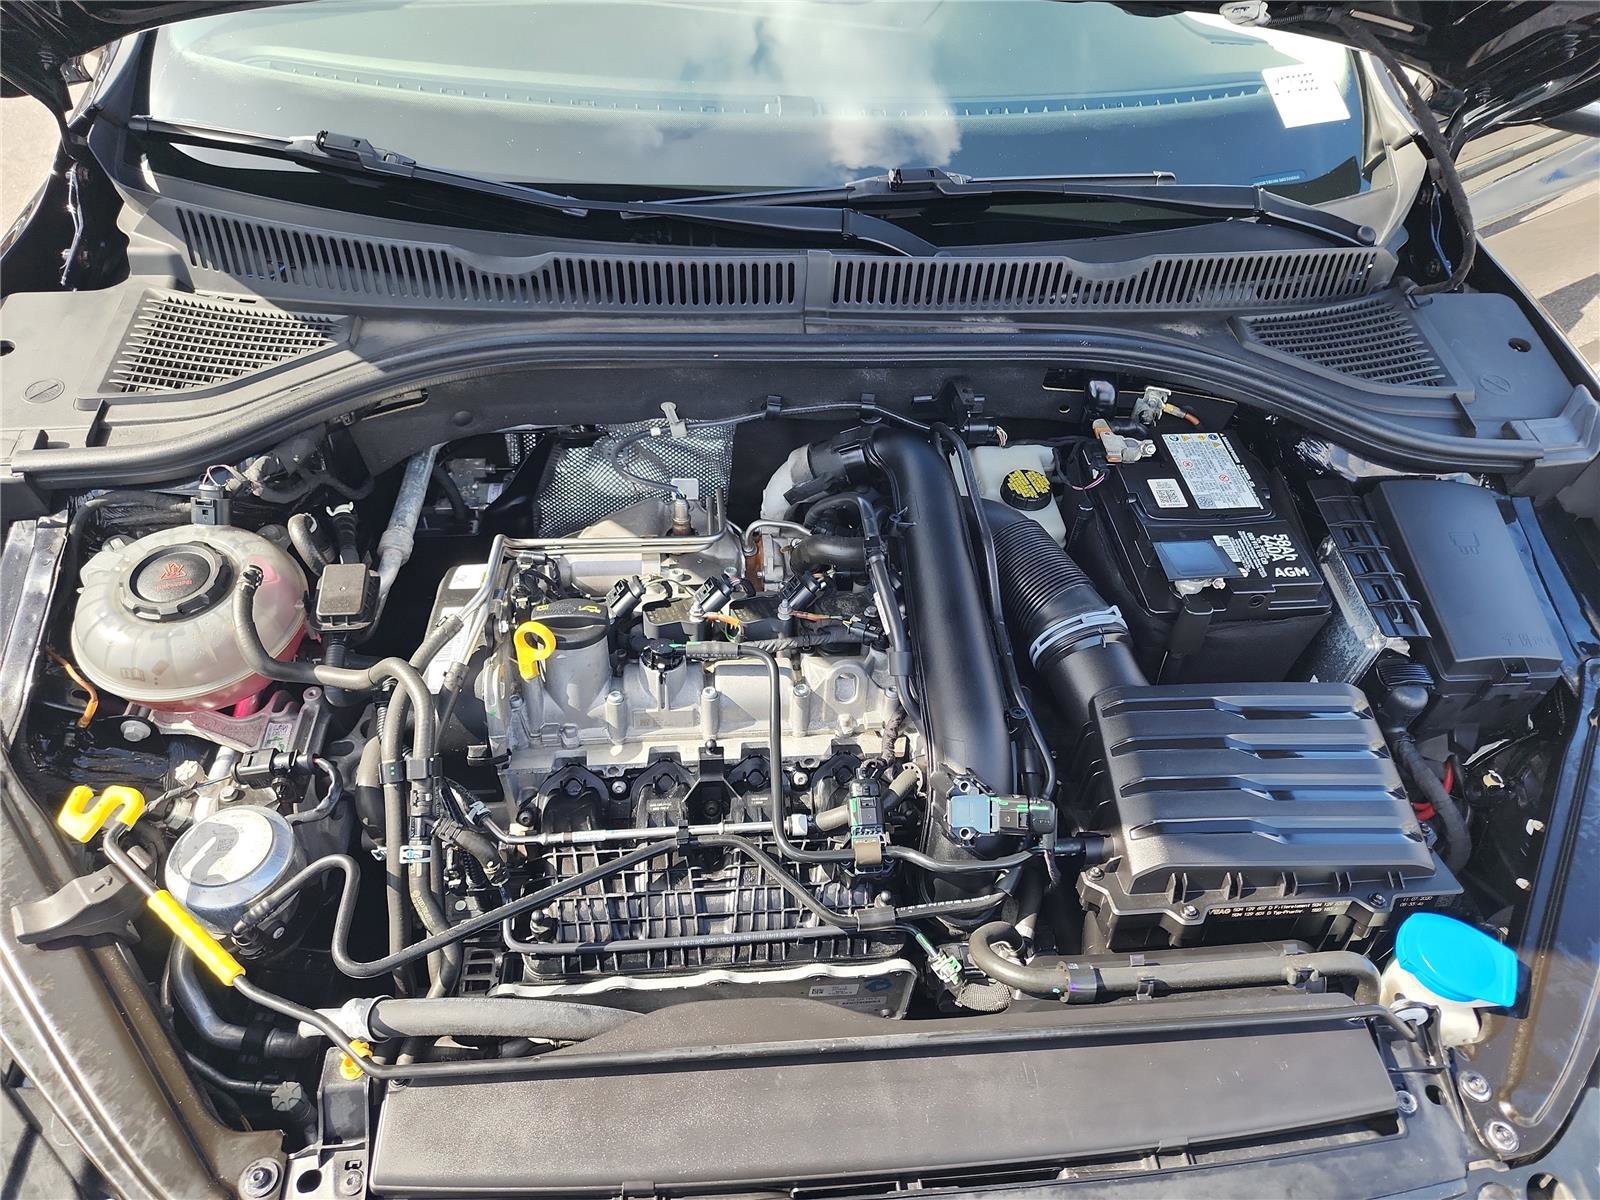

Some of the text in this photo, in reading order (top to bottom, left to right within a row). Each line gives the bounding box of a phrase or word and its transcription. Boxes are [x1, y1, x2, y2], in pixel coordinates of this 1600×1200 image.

[1260, 535, 1285, 562] 640A
[1273, 534, 1298, 561] 58Ah
[1275, 566, 1310, 578] AGM
